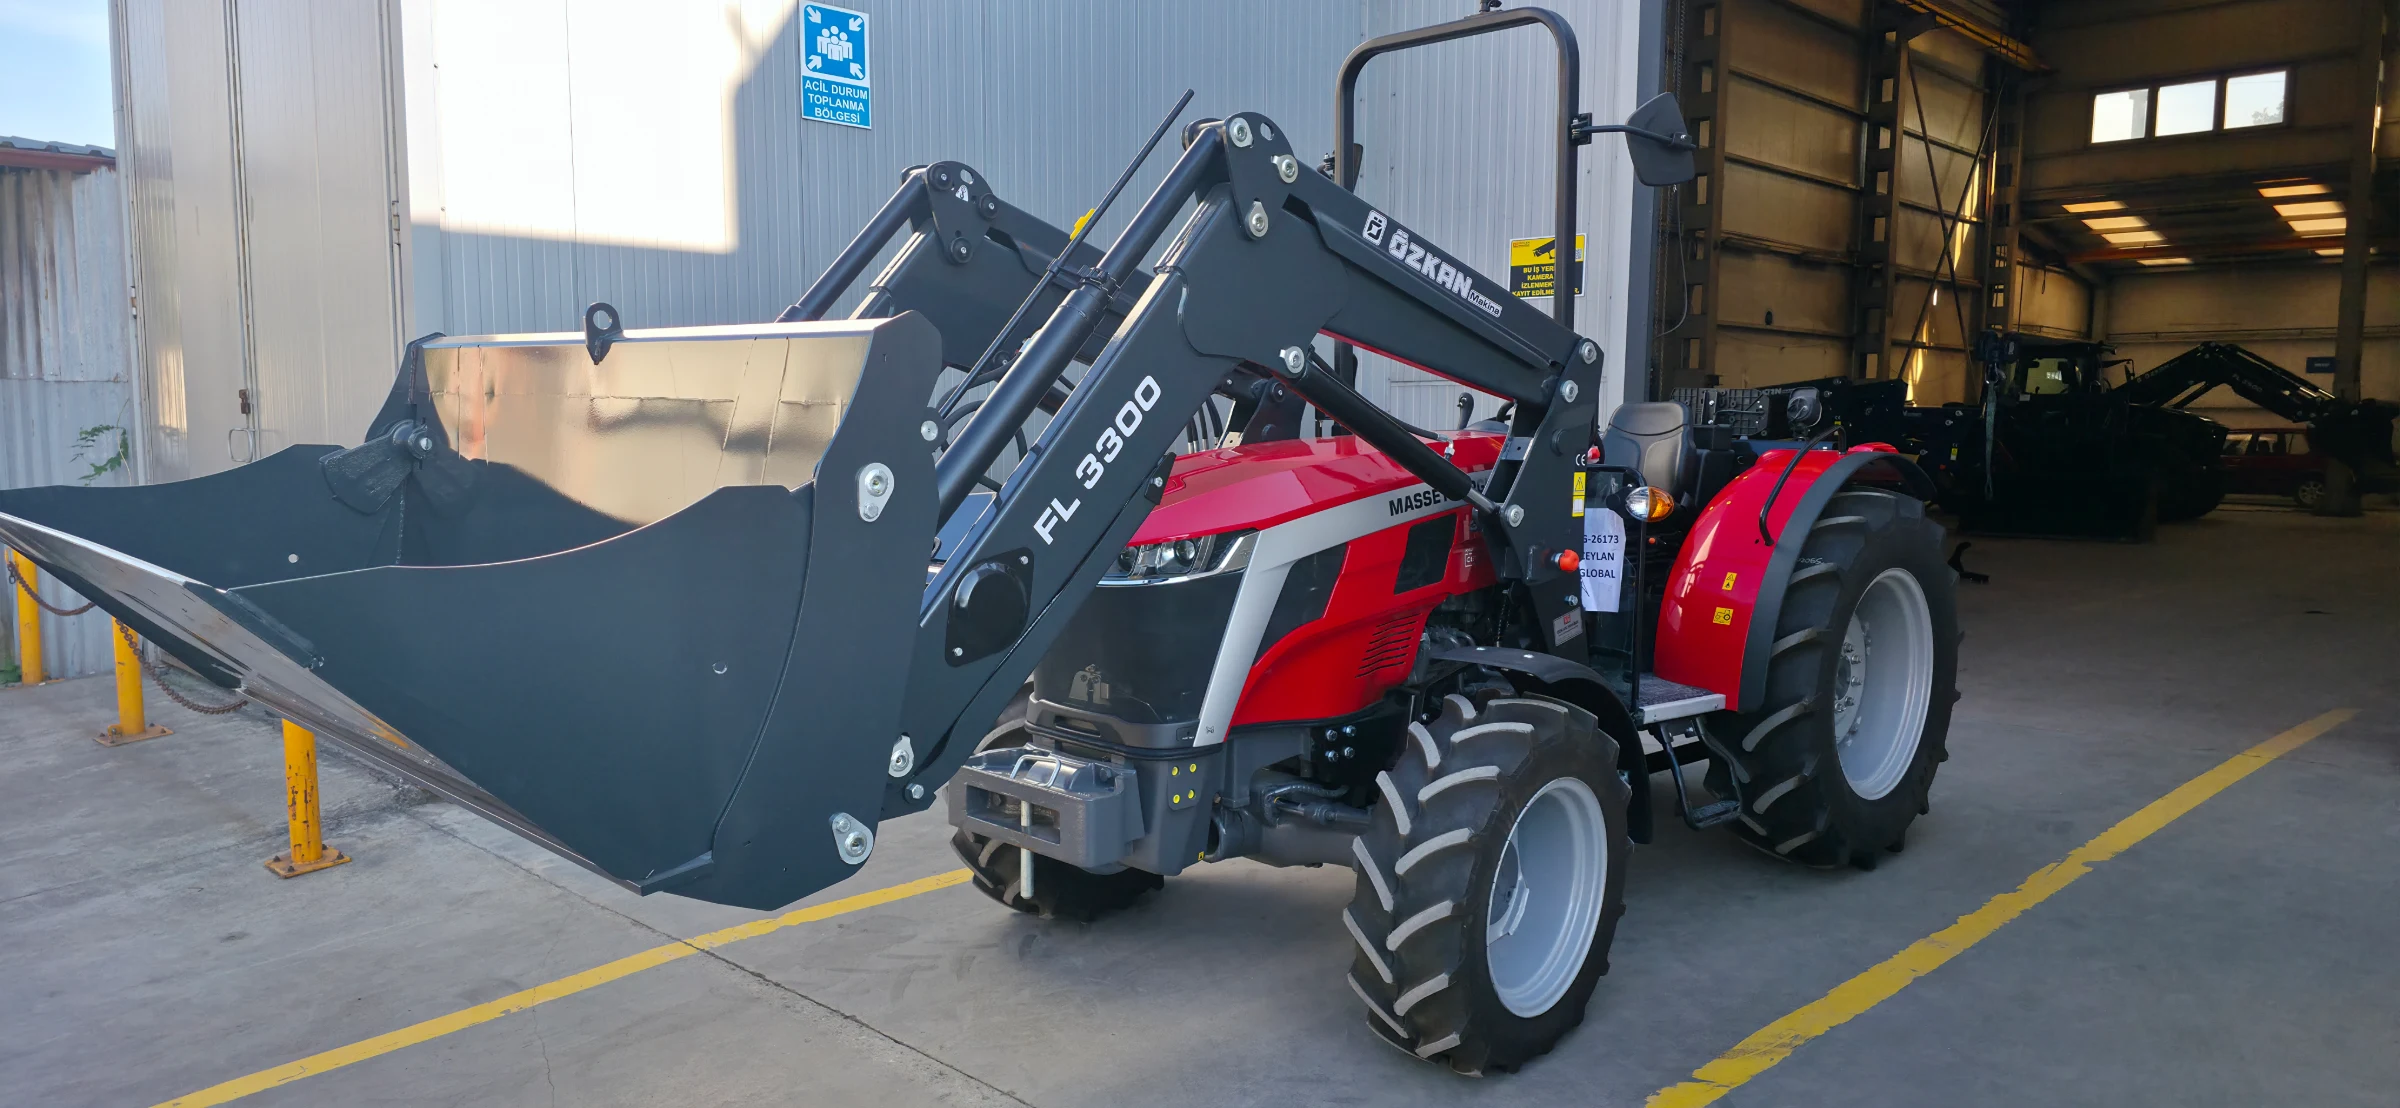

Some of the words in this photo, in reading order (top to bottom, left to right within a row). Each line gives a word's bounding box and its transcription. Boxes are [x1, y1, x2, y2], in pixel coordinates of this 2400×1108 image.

[805, 80, 828, 93] ACİL
[832, 84, 867, 100] DURUM
[808, 93, 865, 112] TOPLANMA
[815, 107, 860, 123] BÖLGESİ
[1388, 228, 1472, 299] ÖZKAN
[1469, 291, 1500, 316] Makina
[1527, 273, 1554, 281] KAMERA
[1521, 281, 1554, 289] İZLENMEK
[1034, 497, 1081, 545] FL
[1076, 375, 1161, 490] 3300
[1575, 453, 1586, 466] CE
[1389, 489, 1447, 517] MASSE
[1583, 552, 1615, 561] EYLAN
[1580, 568, 1616, 579] GLOBAL
